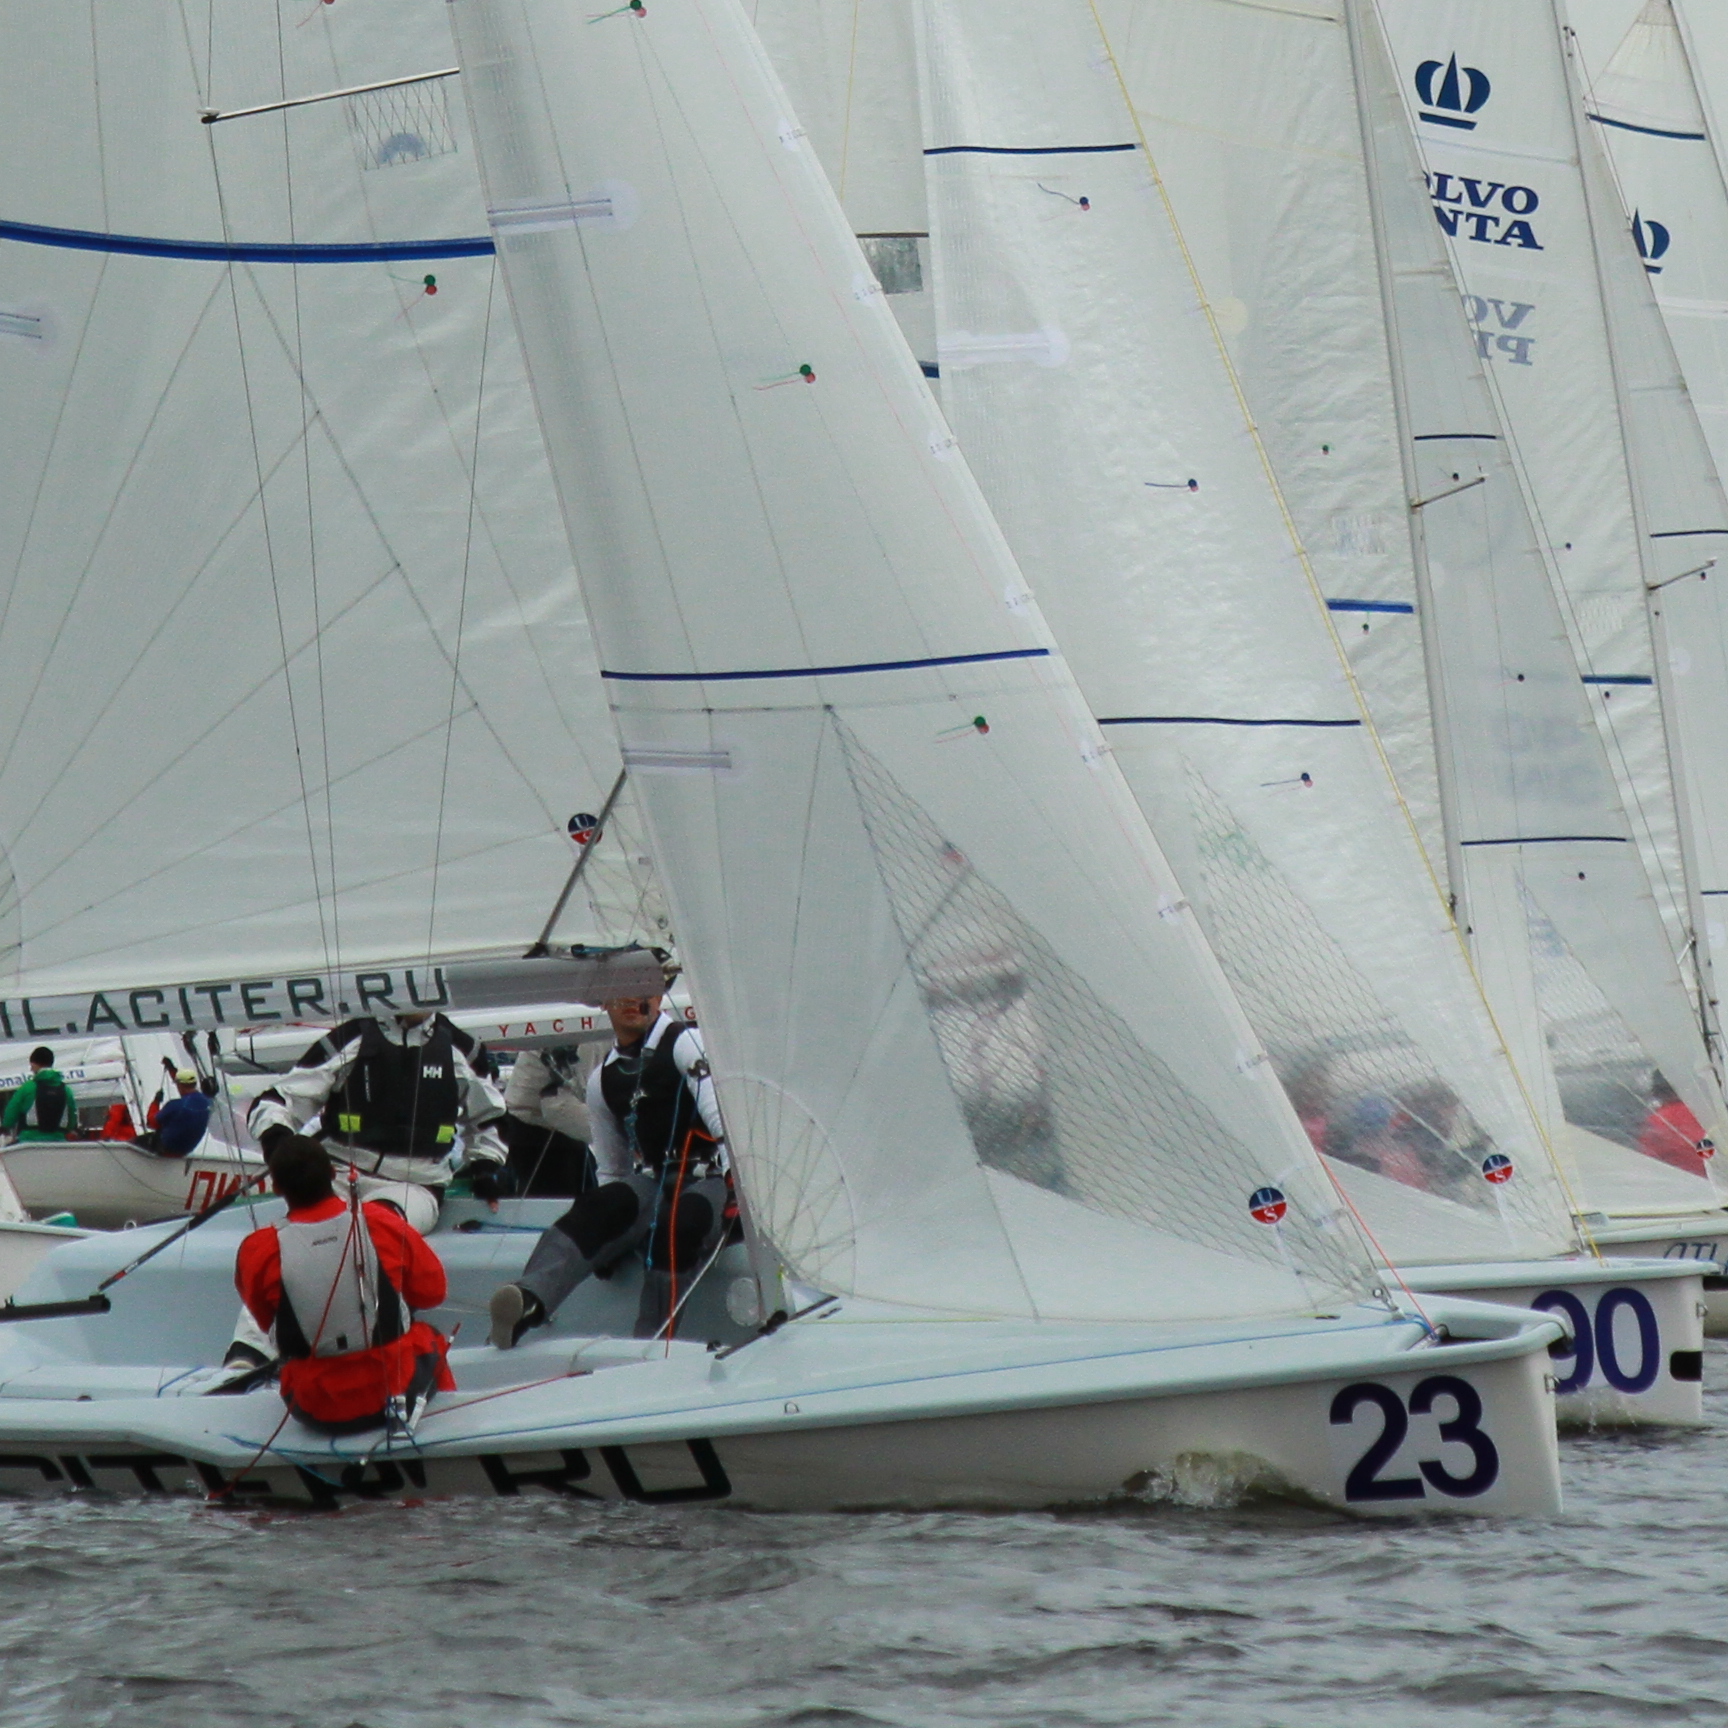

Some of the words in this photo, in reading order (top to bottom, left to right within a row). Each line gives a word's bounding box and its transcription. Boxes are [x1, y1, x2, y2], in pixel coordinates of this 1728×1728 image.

[1422, 170, 1540, 215] LVO
[422, 1065, 443, 1079] HH
[1529, 1289, 1661, 1395] 90
[1329, 1374, 1500, 1503] 23
